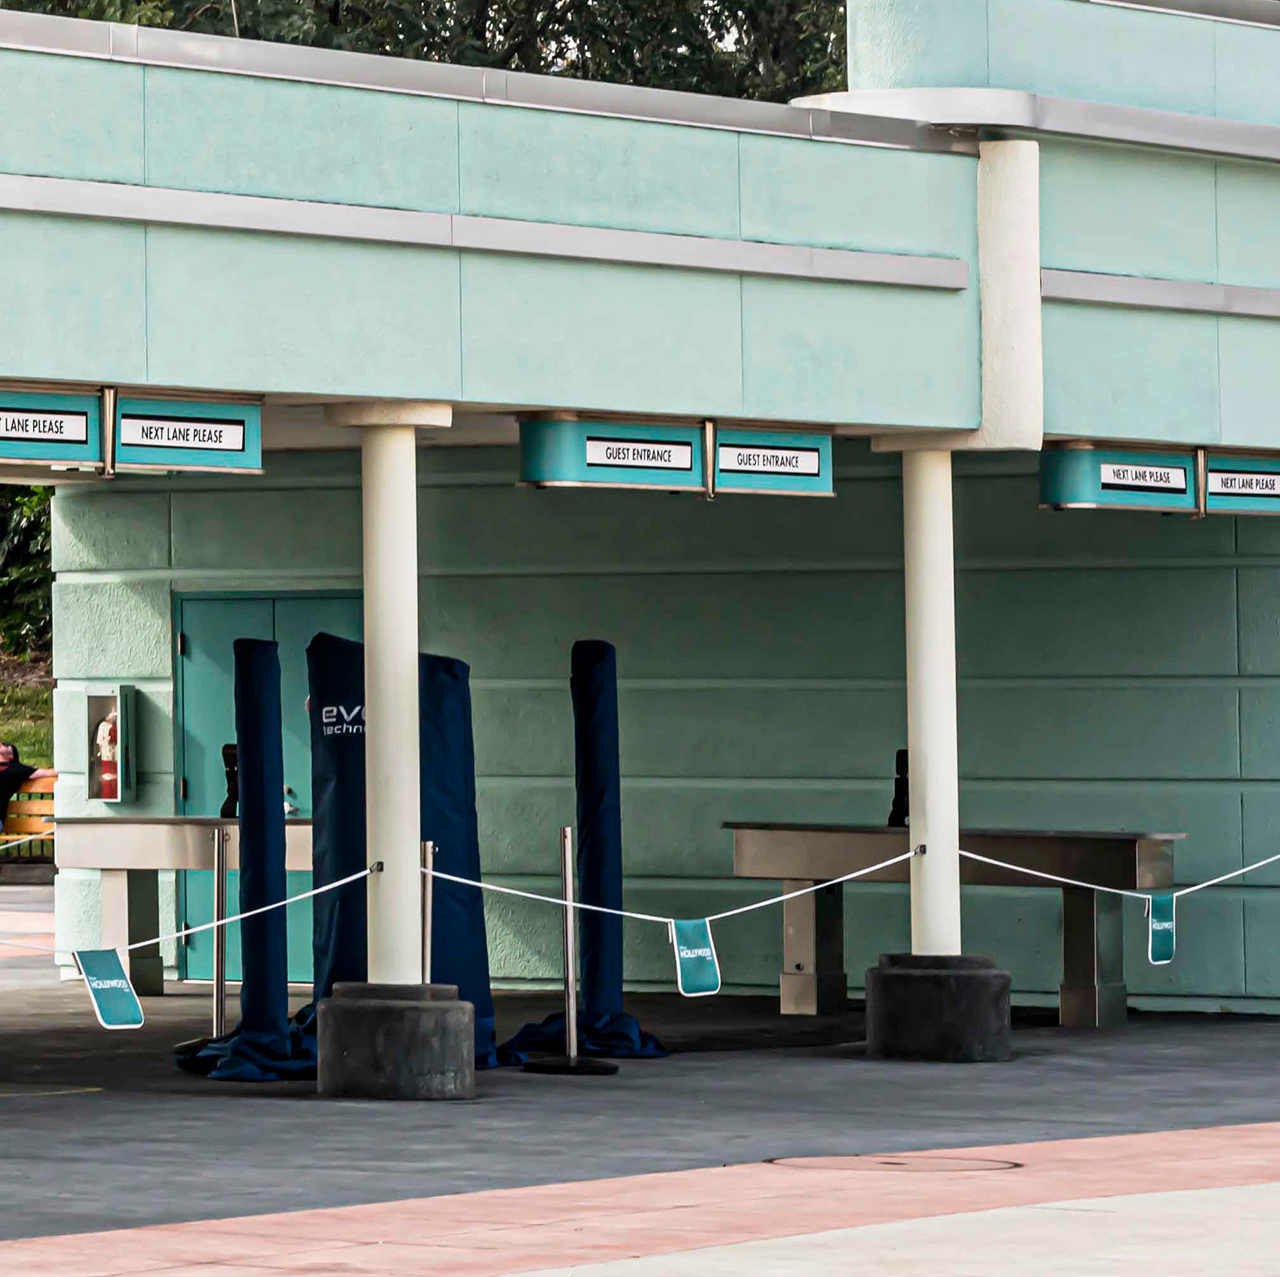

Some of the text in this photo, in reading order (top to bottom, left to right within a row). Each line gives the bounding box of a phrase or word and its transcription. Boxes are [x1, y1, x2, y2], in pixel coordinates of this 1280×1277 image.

[5, 417, 29, 433] LANE
[32, 419, 64, 435] PLEASE
[141, 425, 223, 444] NEXT LANE PLEASE
[605, 446, 672, 463] GUEST ENTRANCE
[736, 452, 799, 468] GUEST ENTRANCE
[1112, 468, 1171, 484] NEXT LANE PLEASE
[1220, 477, 1276, 491] NEXT LANE PLEASE
[323, 723, 366, 736] techn
